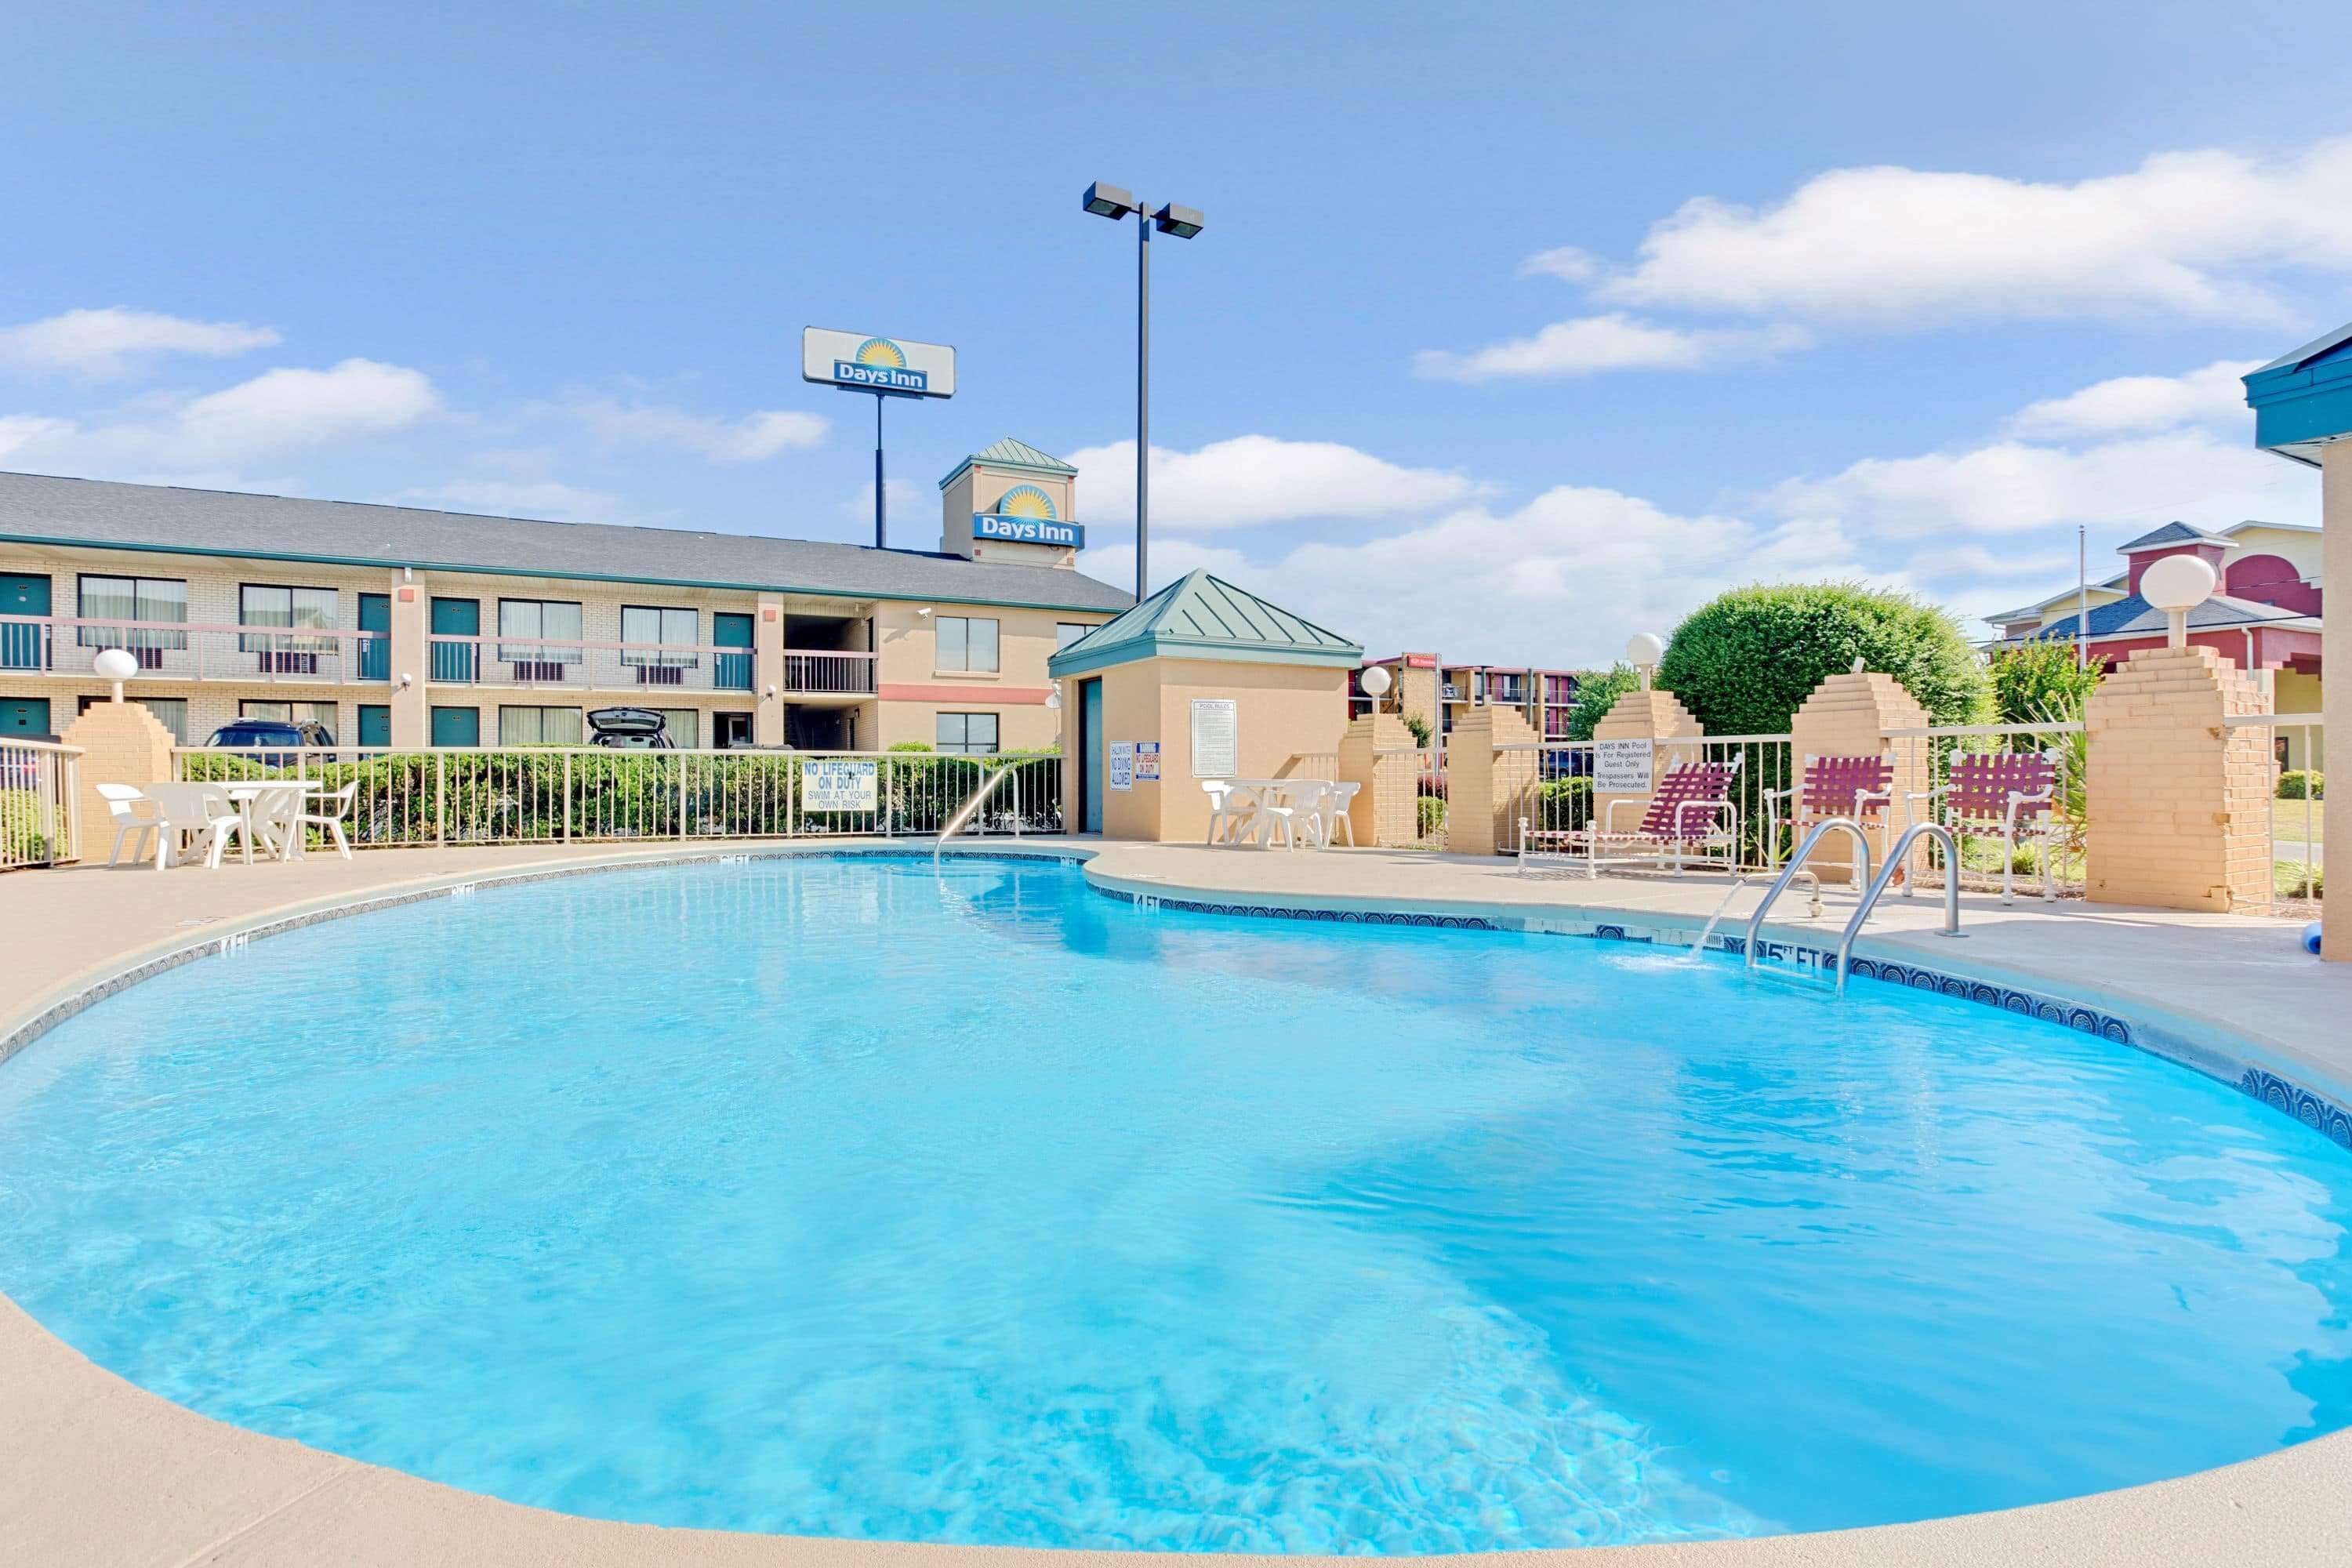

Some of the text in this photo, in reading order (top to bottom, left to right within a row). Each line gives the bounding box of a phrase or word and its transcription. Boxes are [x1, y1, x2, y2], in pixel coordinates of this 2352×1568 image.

[840, 364, 923, 387] Days Inn
[982, 517, 1073, 541] Days Inn
[804, 763, 874, 775] NO LIFEGUARD
[818, 777, 861, 789] ON DUTY
[808, 791, 871, 800] SWIM AT YOUR
[818, 800, 861, 809] OWN RISK
[1768, 943, 1820, 967] 5 FT FT
